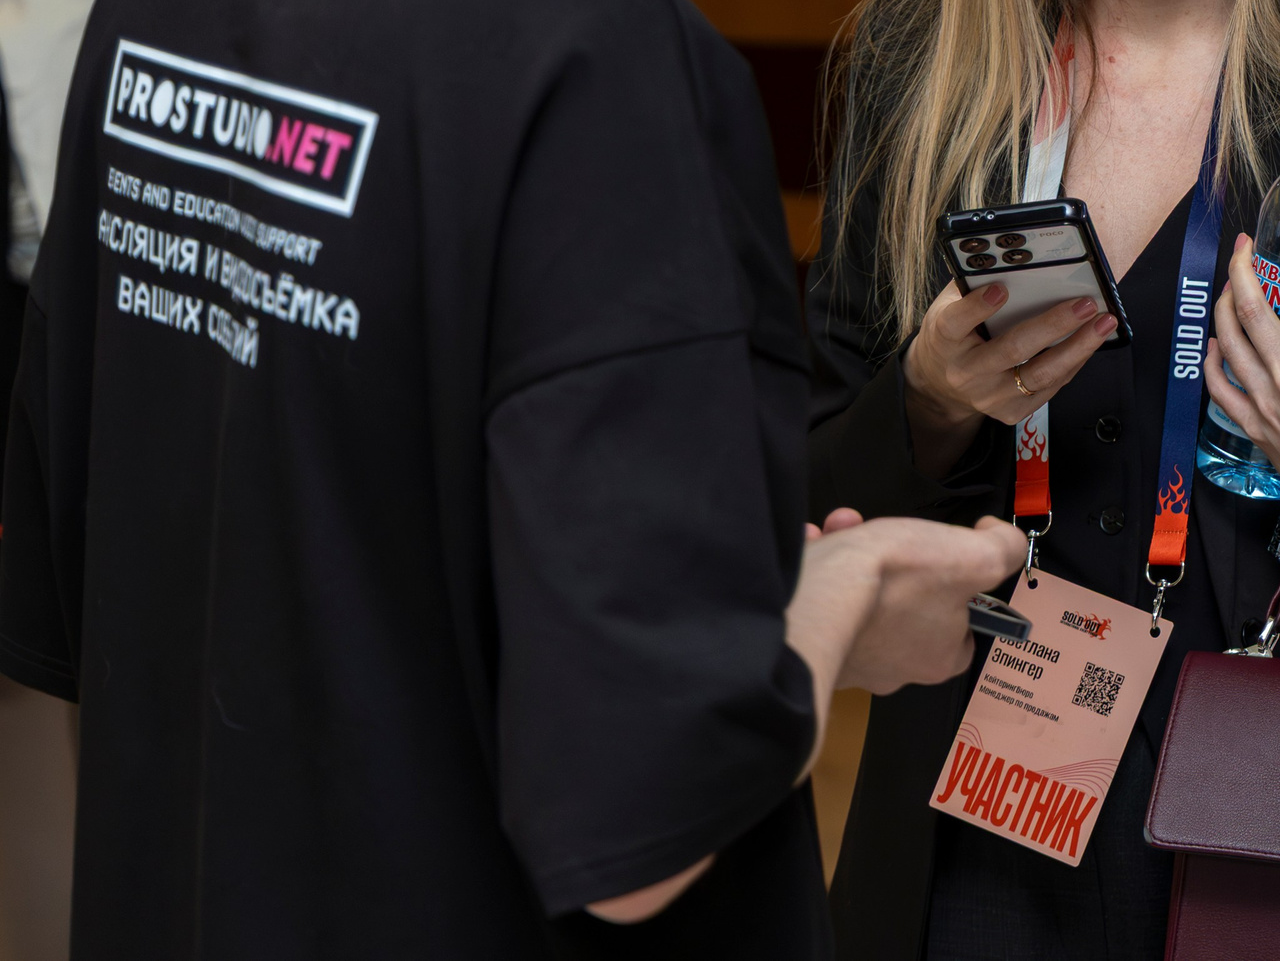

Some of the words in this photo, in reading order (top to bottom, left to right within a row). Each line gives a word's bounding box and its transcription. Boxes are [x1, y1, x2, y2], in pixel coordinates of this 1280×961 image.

[142, 182, 171, 212] AND
[205, 243, 220, 283] И
[117, 274, 203, 336] ВАШИХ
[1180, 276, 1209, 318] OUT
[1174, 324, 1203, 381] SOLD
[1062, 610, 1085, 627] SOLD
[1084, 619, 1102, 634] OUT
[991, 647, 1044, 681] Эпингер
[979, 684, 1015, 705] Менеджер
[1015, 699, 1024, 708] по
[1023, 702, 1060, 722] продажам
[936, 741, 1099, 859] УЧАСТНИК
